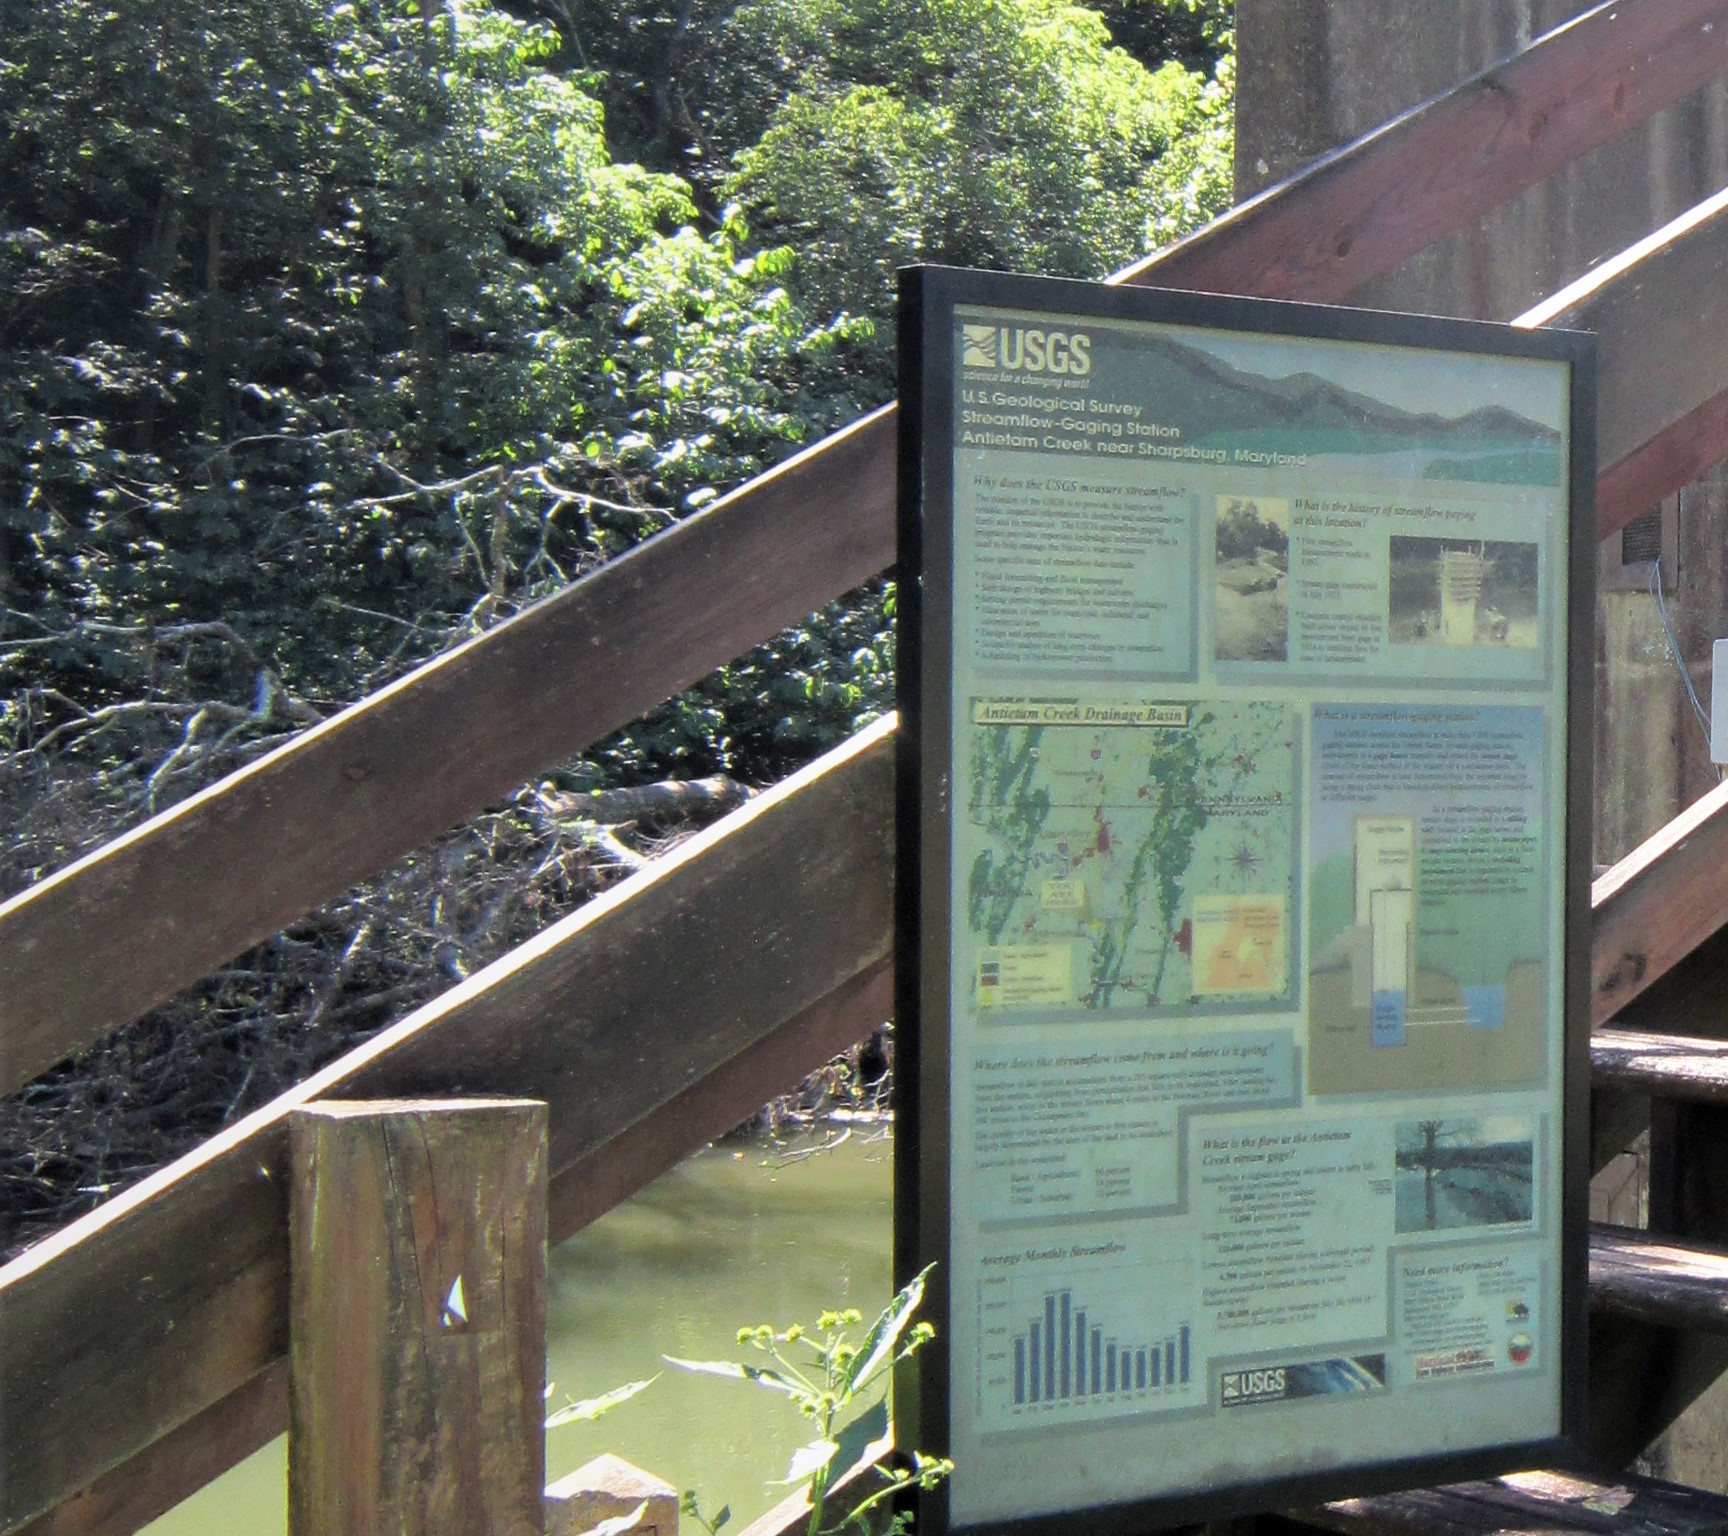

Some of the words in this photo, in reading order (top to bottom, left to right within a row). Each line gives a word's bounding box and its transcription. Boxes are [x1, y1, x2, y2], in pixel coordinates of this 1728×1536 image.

[1000, 327, 1091, 375] USGS
[1021, 374, 1062, 390] changing
[992, 392, 1085, 413] Geological
[1090, 399, 1142, 418] Survey
[962, 410, 1122, 437] Streamflow-Gaging
[1127, 421, 1180, 437] Station
[962, 430, 1038, 449] Antietam
[1043, 435, 1092, 452] Creek
[1097, 441, 1135, 454] near
[1138, 442, 1229, 463] Sharpsburg,
[1235, 449, 1307, 467] Maryland
[974, 475, 996, 489] Why
[999, 477, 1023, 489] does
[1026, 478, 1043, 490] the
[1046, 480, 1078, 492] USGS
[1081, 484, 1122, 495] measure
[1126, 486, 1186, 499] streamflow?
[1295, 498, 1320, 512] What
[1322, 502, 1329, 511] is
[1332, 501, 1347, 512] the
[1349, 503, 1380, 516] history
[1383, 504, 1393, 517] of
[1394, 505, 1442, 520] streamflow
[1305, 516, 1322, 527] this
[1325, 518, 1367, 528] location?
[984, 707, 1039, 720] Antietam
[1044, 707, 1079, 720] Creek
[1085, 708, 1143, 723] Drainage
[1147, 709, 1182, 722] Basin
[974, 1059, 1007, 1070] Where
[1011, 1058, 1032, 1069] does
[1036, 1057, 1053, 1067] the
[1055, 1053, 1110, 1068] streamflow
[1113, 1054, 1140, 1064] come
[1142, 1051, 1166, 1065] from
[1169, 1049, 1188, 1061] and
[1190, 1048, 1219, 1061] where
[1241, 1043, 1274, 1059] going?
[1203, 1138, 1229, 1149] What
[1241, 1137, 1255, 1147] the
[1258, 1136, 1279, 1149] flow
[1293, 1133, 1307, 1143] the
[1311, 1130, 1351, 1143] Antietam
[1202, 1154, 1232, 1165] Creek
[1234, 1153, 1264, 1164] stream
[980, 1254, 1022, 1265] Average
[1025, 1248, 1067, 1262] Monthly
[1070, 1241, 1127, 1258] Streamflow
[1403, 1267, 1425, 1277] Need
[1427, 1266, 1450, 1275] more
[1452, 1256, 1509, 1274] information?
[1241, 1369, 1286, 1395] USGS
